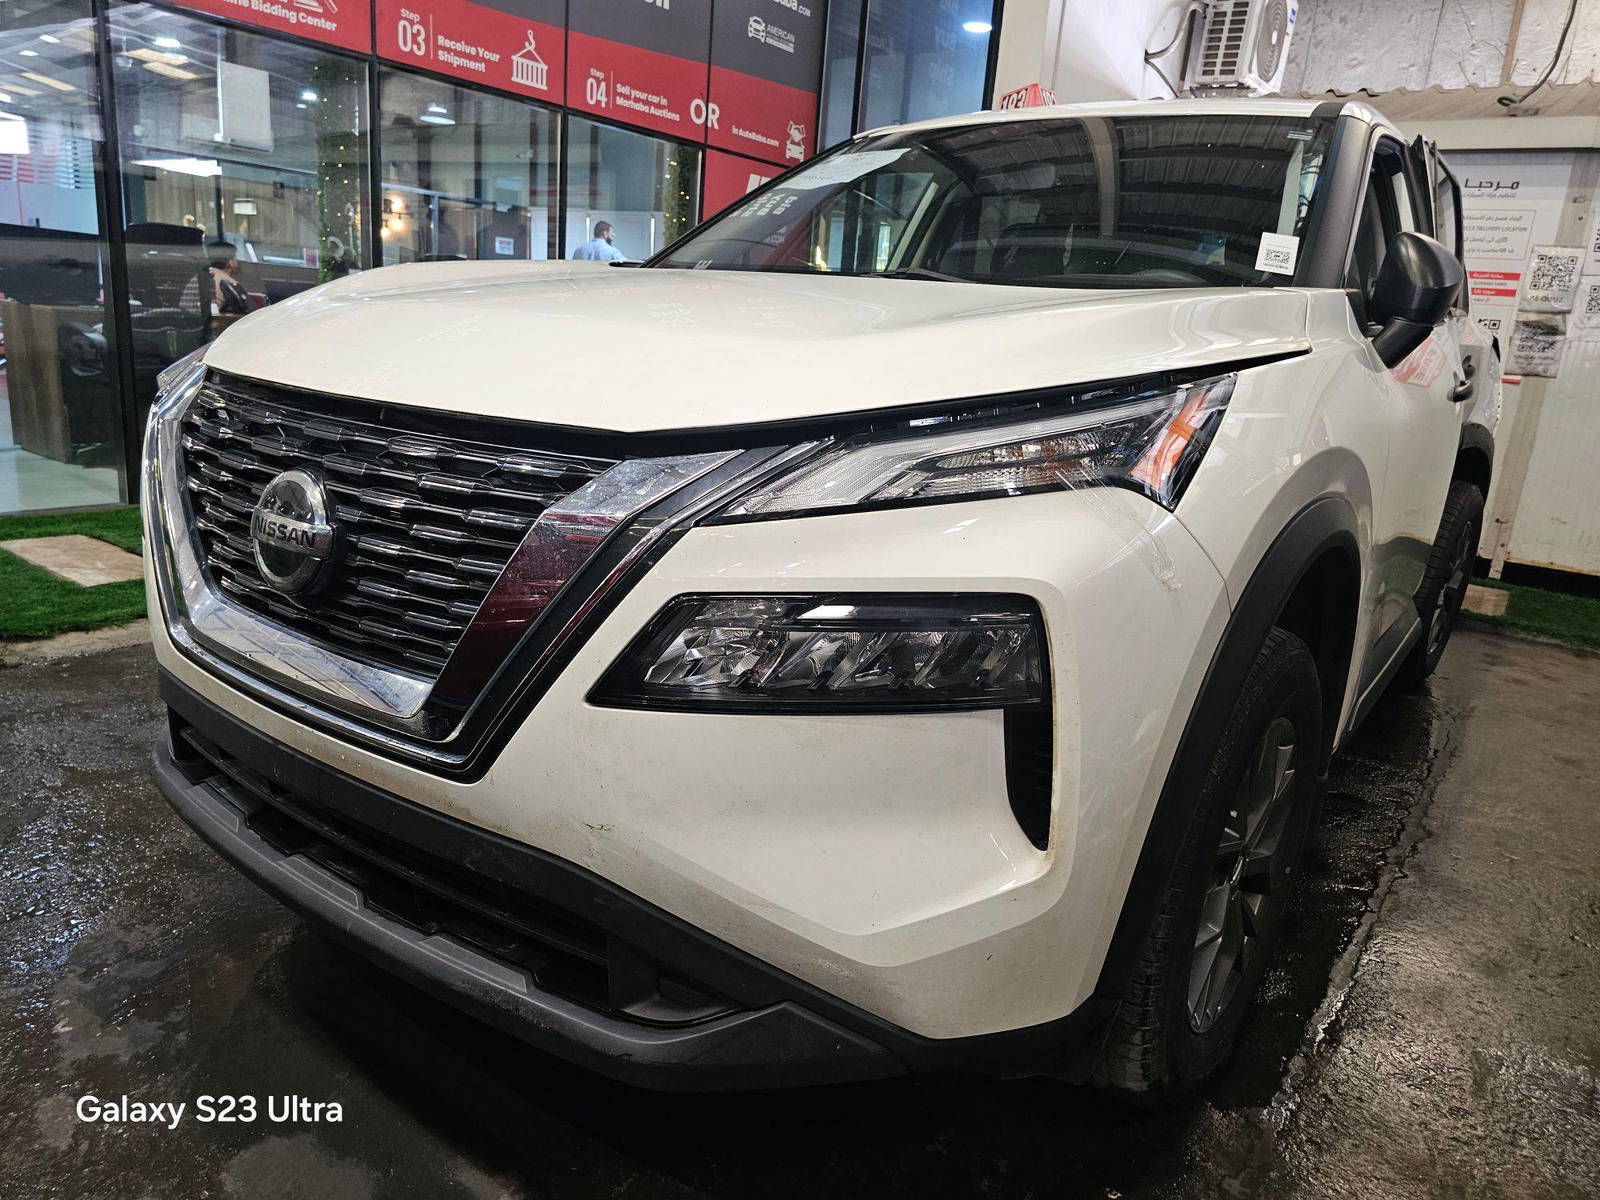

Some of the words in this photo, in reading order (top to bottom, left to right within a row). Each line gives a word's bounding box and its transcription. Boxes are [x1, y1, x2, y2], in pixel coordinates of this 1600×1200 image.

[251, 0, 298, 24] Bidding
[298, 12, 337, 31] Center
[400, 8, 420, 23] Step
[398, 20, 426, 56] 03
[437, 35, 477, 55] Receive
[477, 46, 500, 62] Your
[437, 50, 486, 73] Shipment
[590, 68, 604, 80] Step
[587, 77, 608, 109] 04
[616, 83, 631, 96] Sell
[631, 89, 648, 100] your
[647, 94, 660, 104] car
[660, 95, 668, 106] in
[616, 96, 650, 113] Marhaba
[649, 105, 680, 122] Auctions
[690, 98, 720, 130] OR
[1464, 178, 1520, 191] مرحبا
[256, 514, 316, 548] NISSAN
